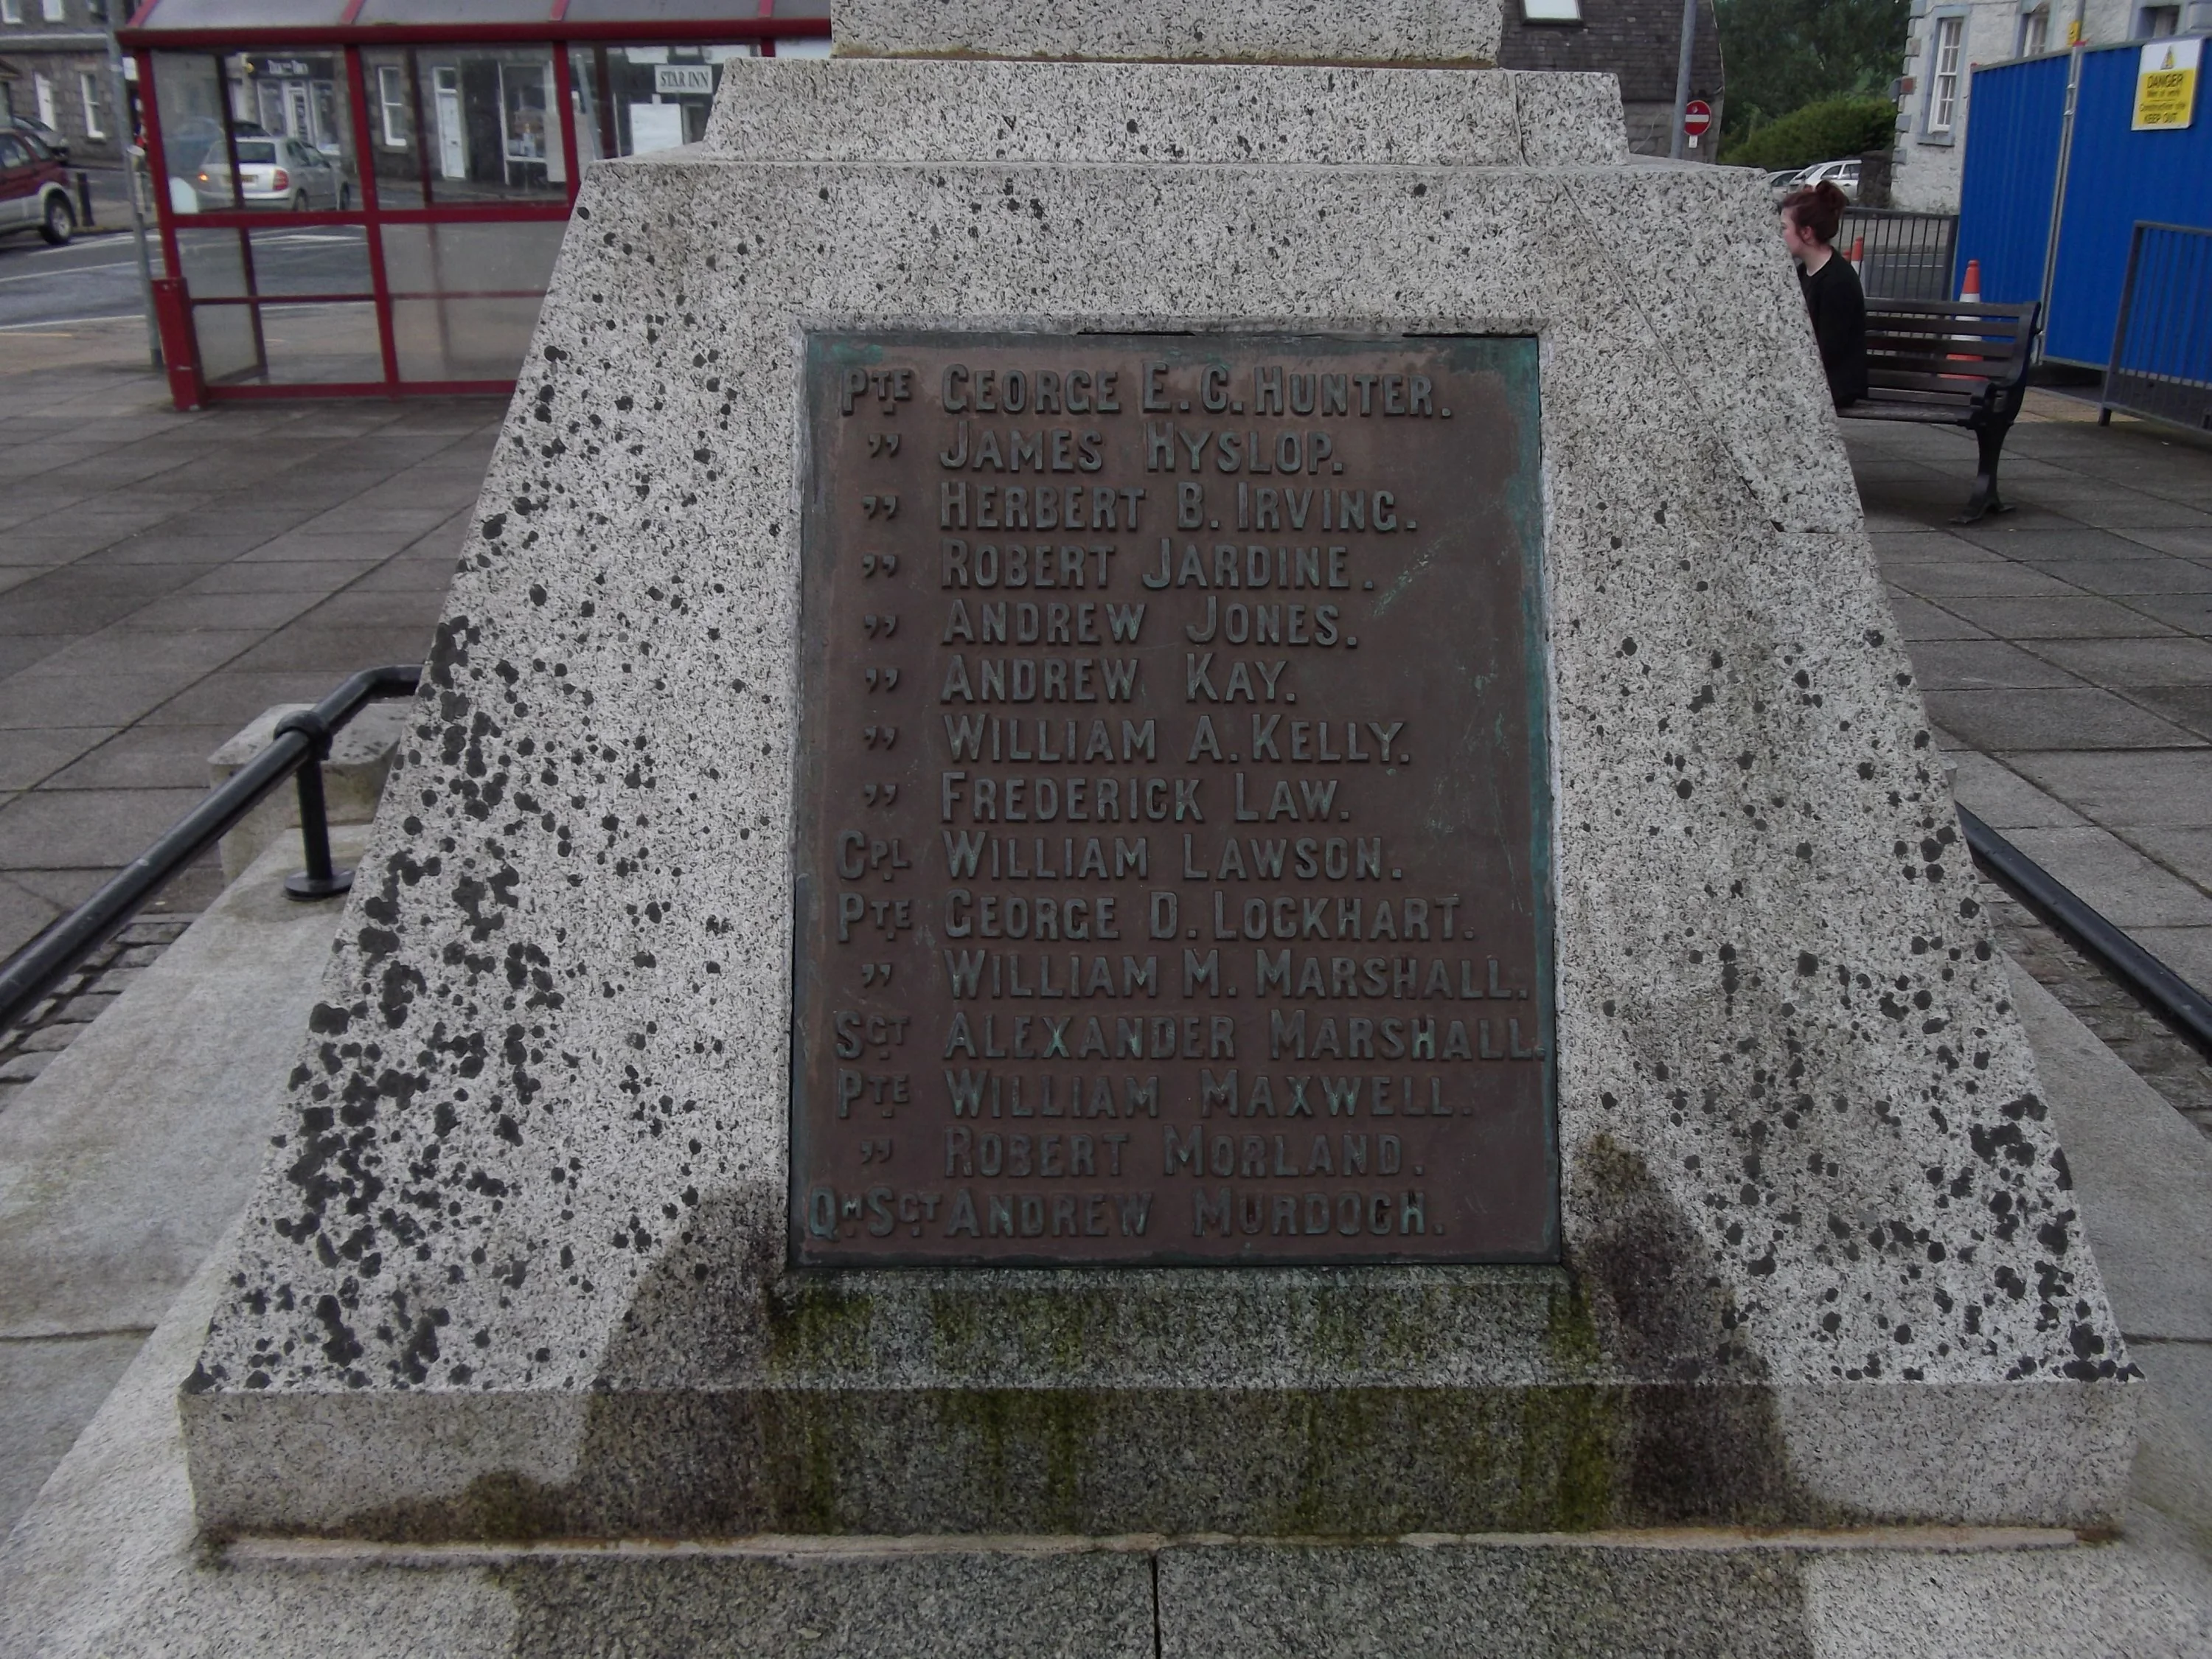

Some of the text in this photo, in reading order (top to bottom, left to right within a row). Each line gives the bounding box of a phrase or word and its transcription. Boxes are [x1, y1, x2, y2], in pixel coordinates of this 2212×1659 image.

[661, 71, 709, 87] STAR INN
[2146, 74, 2183, 88] DANGER
[2144, 112, 2178, 124] KEEP OUT
[942, 364, 1121, 414] GEORGE
[940, 422, 1103, 473] JAMES
[941, 481, 1147, 530] HERBERT
[941, 538, 1116, 589] ROBERT
[942, 599, 1146, 645] ANDREW
[940, 655, 1138, 704] ANDREW
[942, 714, 1155, 763] WILLIAM
[942, 771, 1204, 823] FREDERICK
[942, 830, 1148, 880] WILLIAM
[945, 888, 1120, 941] GEORGE
[943, 949, 1158, 999] WILLIAM
[943, 1012, 1236, 1060] ALEXANDER
[945, 1068, 1159, 1118] WILLIAM
[945, 1124, 1129, 1178] ROBERT
[945, 1187, 1153, 1239] ANDREW
